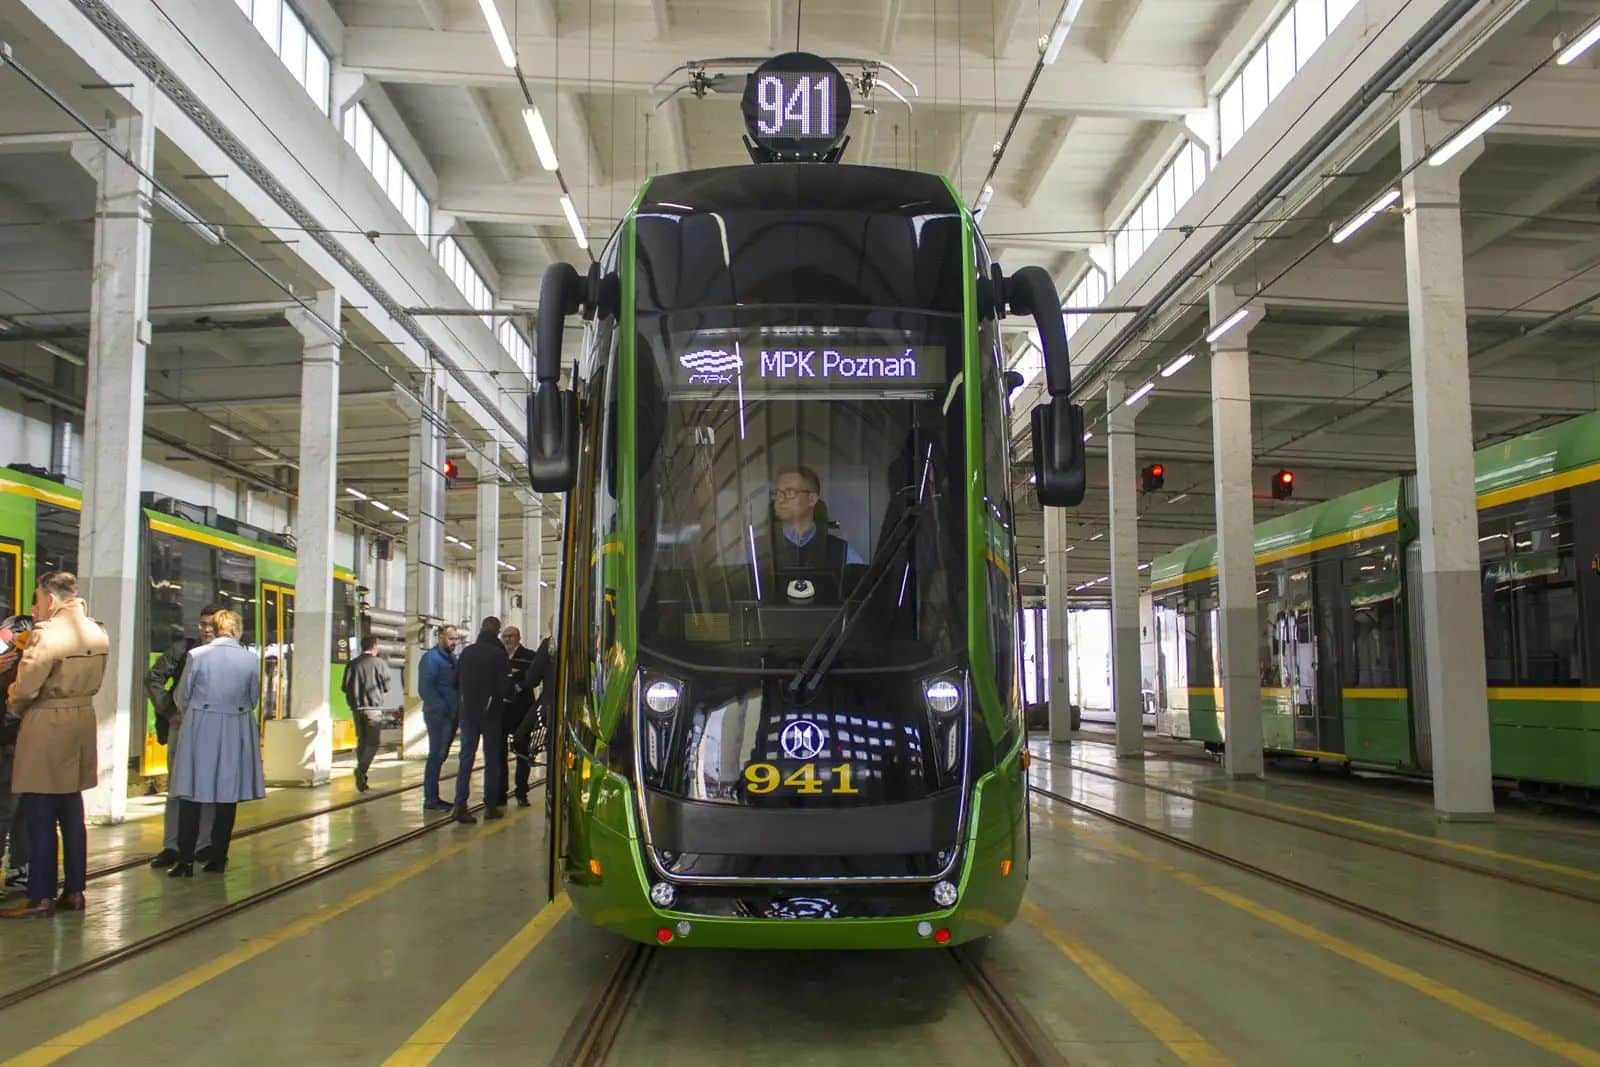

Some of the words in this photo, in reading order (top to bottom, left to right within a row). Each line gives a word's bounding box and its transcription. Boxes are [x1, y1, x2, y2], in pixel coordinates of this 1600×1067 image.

[758, 76, 829, 134] 941
[760, 350, 816, 377] MPK
[823, 348, 917, 377] Poznań
[689, 374, 733, 384] MPK
[744, 763, 859, 794] 941
